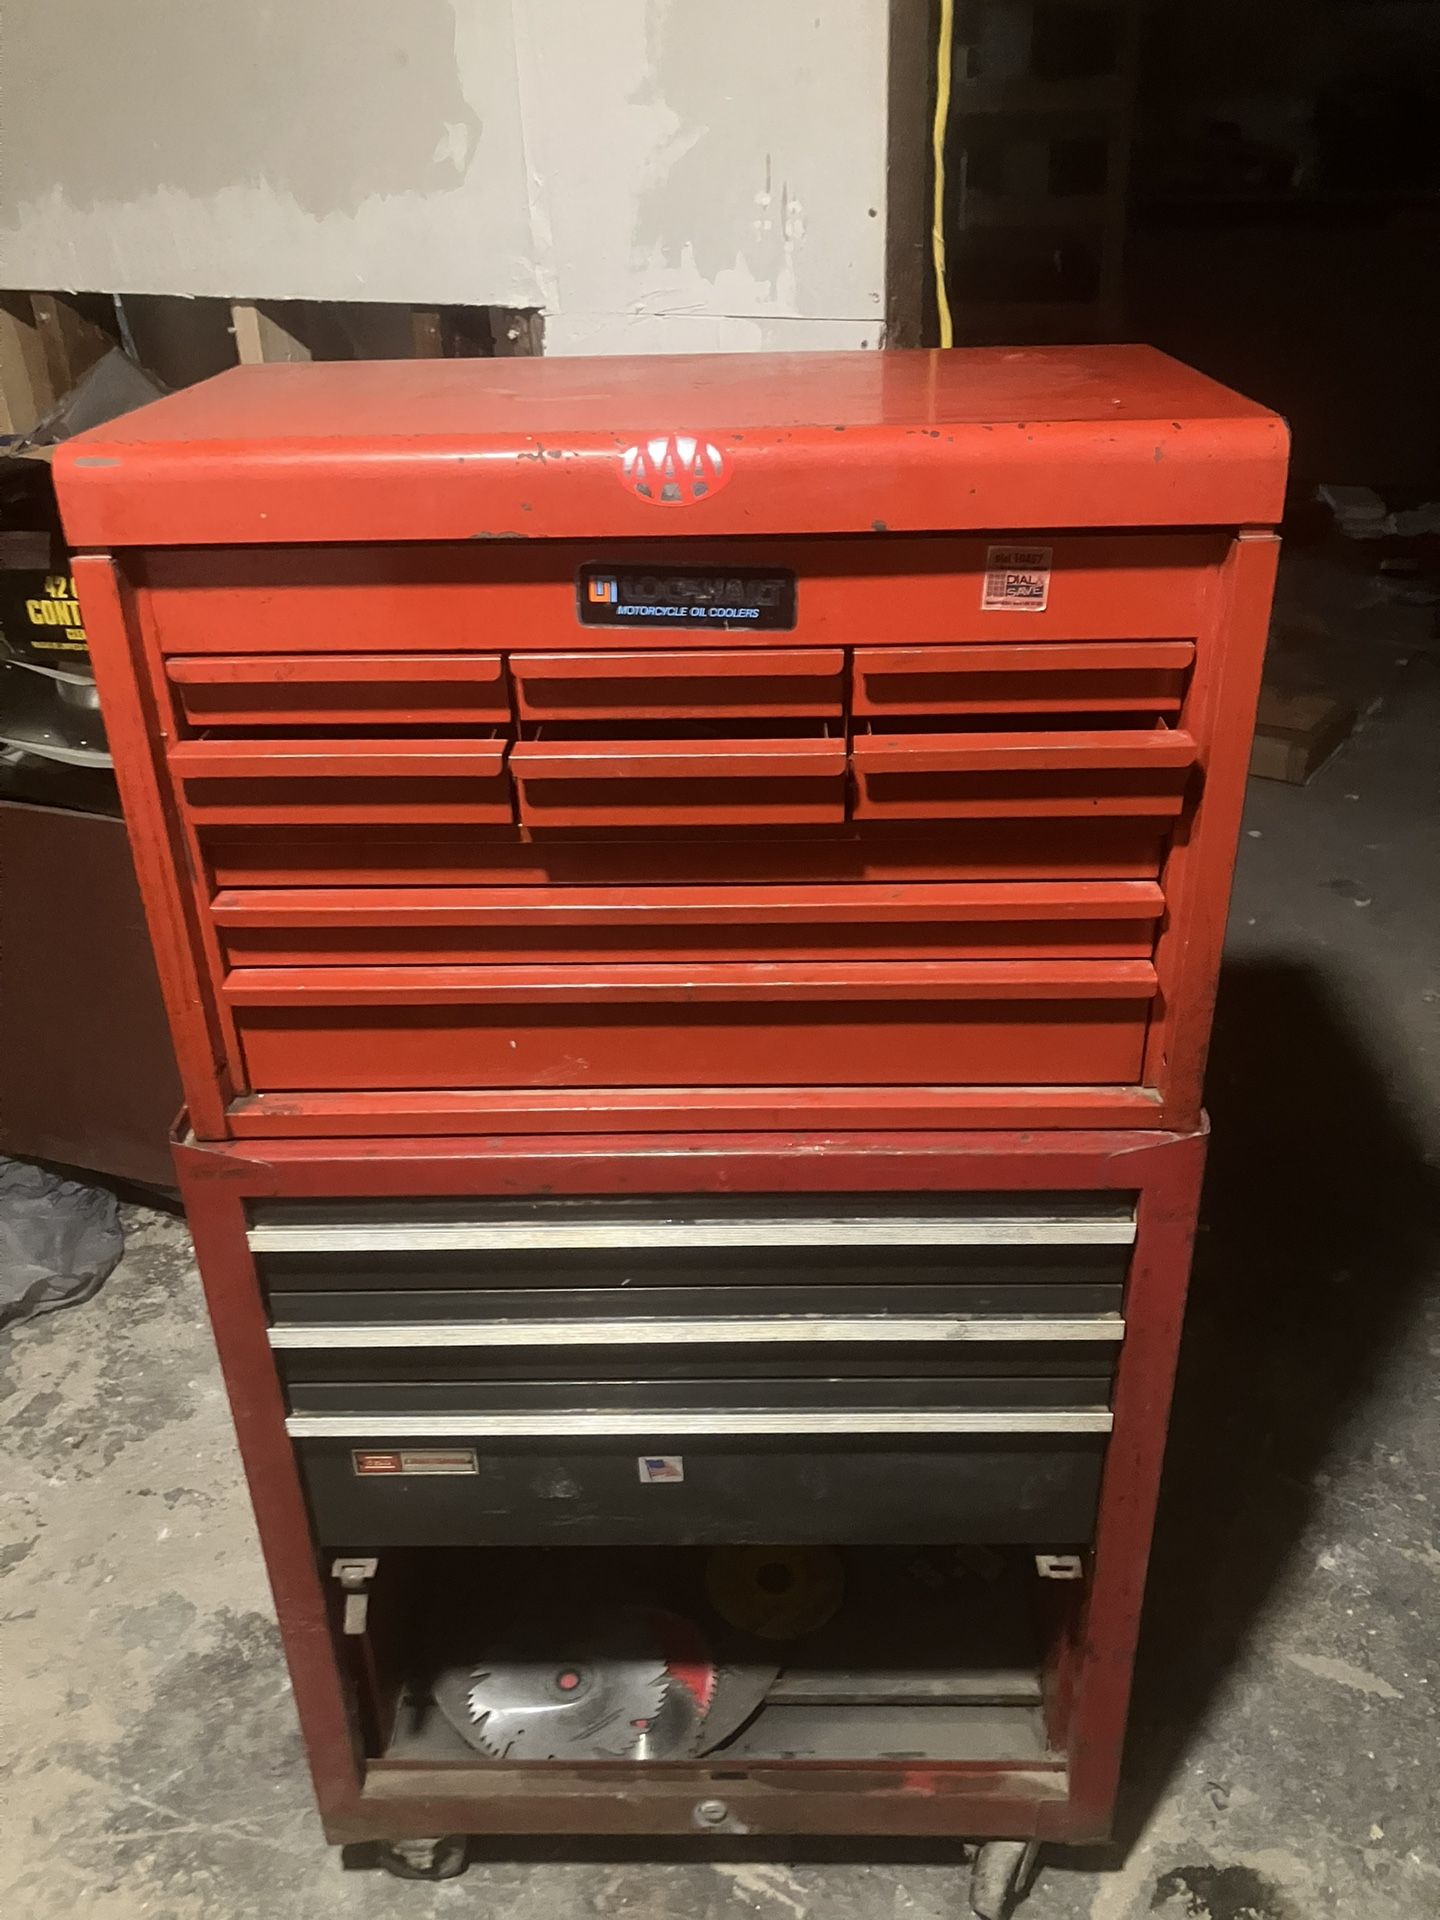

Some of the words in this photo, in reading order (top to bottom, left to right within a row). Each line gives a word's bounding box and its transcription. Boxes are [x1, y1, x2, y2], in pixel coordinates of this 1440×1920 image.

[1007, 574, 1037, 585] DIAL
[1006, 586, 1043, 597] SAVE
[616, 605, 688, 617] MOTORCYCLE
[689, 607, 708, 618] OIL
[709, 608, 760, 618] COOLERS
